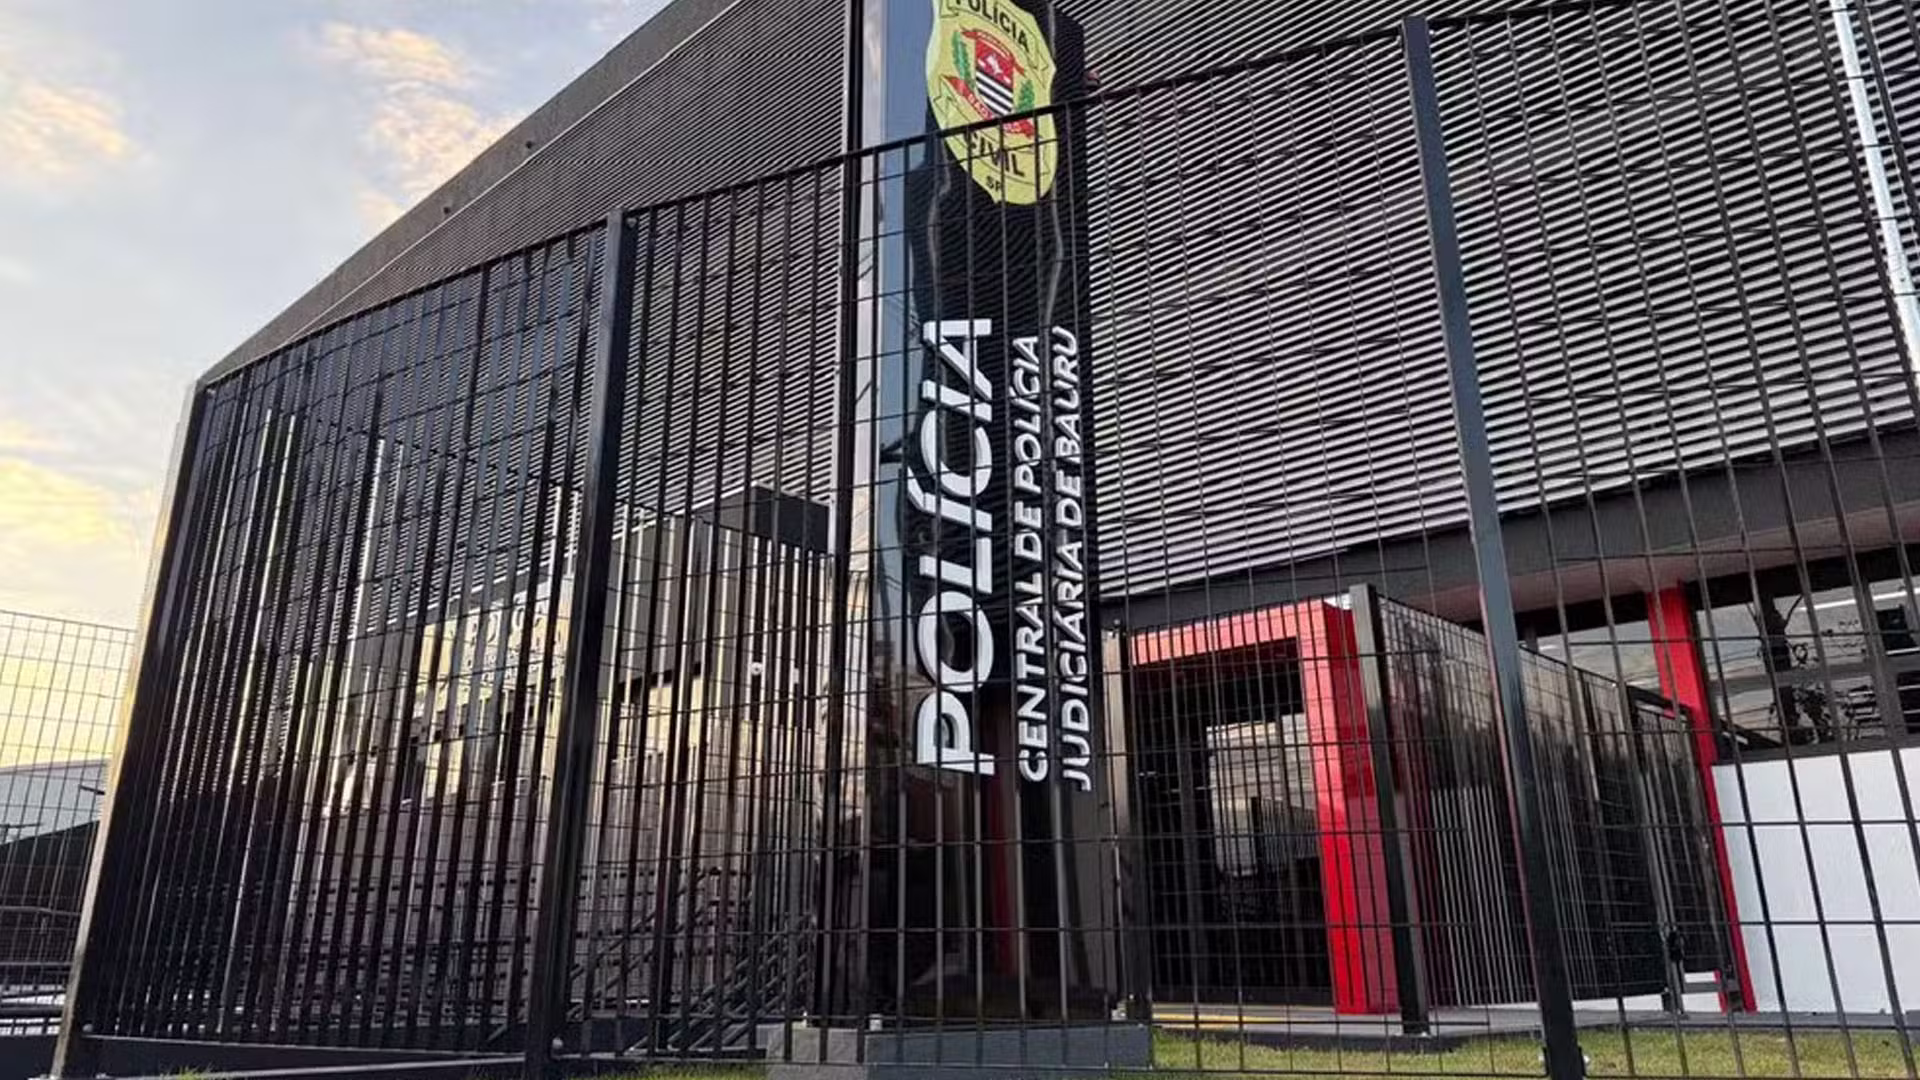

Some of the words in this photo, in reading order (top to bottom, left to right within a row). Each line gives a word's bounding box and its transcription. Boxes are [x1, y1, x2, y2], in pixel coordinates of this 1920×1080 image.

[955, 0, 1029, 53] OLICIA
[1009, 336, 1042, 494] POLÍCIA
[1052, 325, 1082, 464] BAURU
[907, 319, 994, 775] POLÍCIA
[1014, 501, 1042, 562] DE
[1055, 469, 1082, 527] DE
[1015, 572, 1048, 782] CENTRAL
[1053, 541, 1092, 792] JUDICIÁRIA
